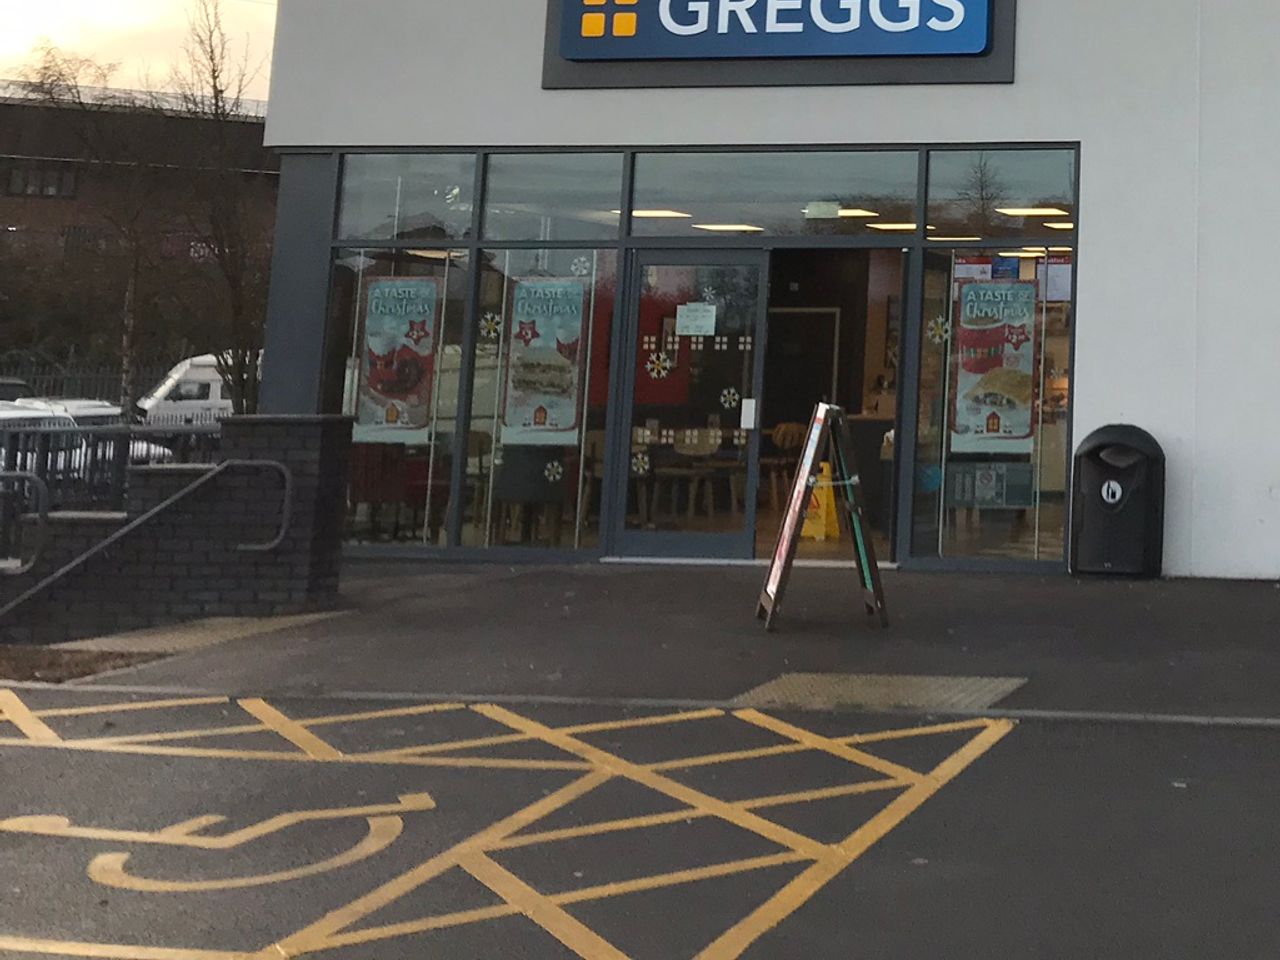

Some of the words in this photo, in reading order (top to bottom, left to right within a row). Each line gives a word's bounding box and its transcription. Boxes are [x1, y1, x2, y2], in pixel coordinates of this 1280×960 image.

[384, 287, 417, 299] TASTE
[529, 287, 563, 299] TASTE
[967, 290, 976, 301] A
[980, 290, 1013, 301] TASTE
[966, 301, 1029, 320] Christmas
